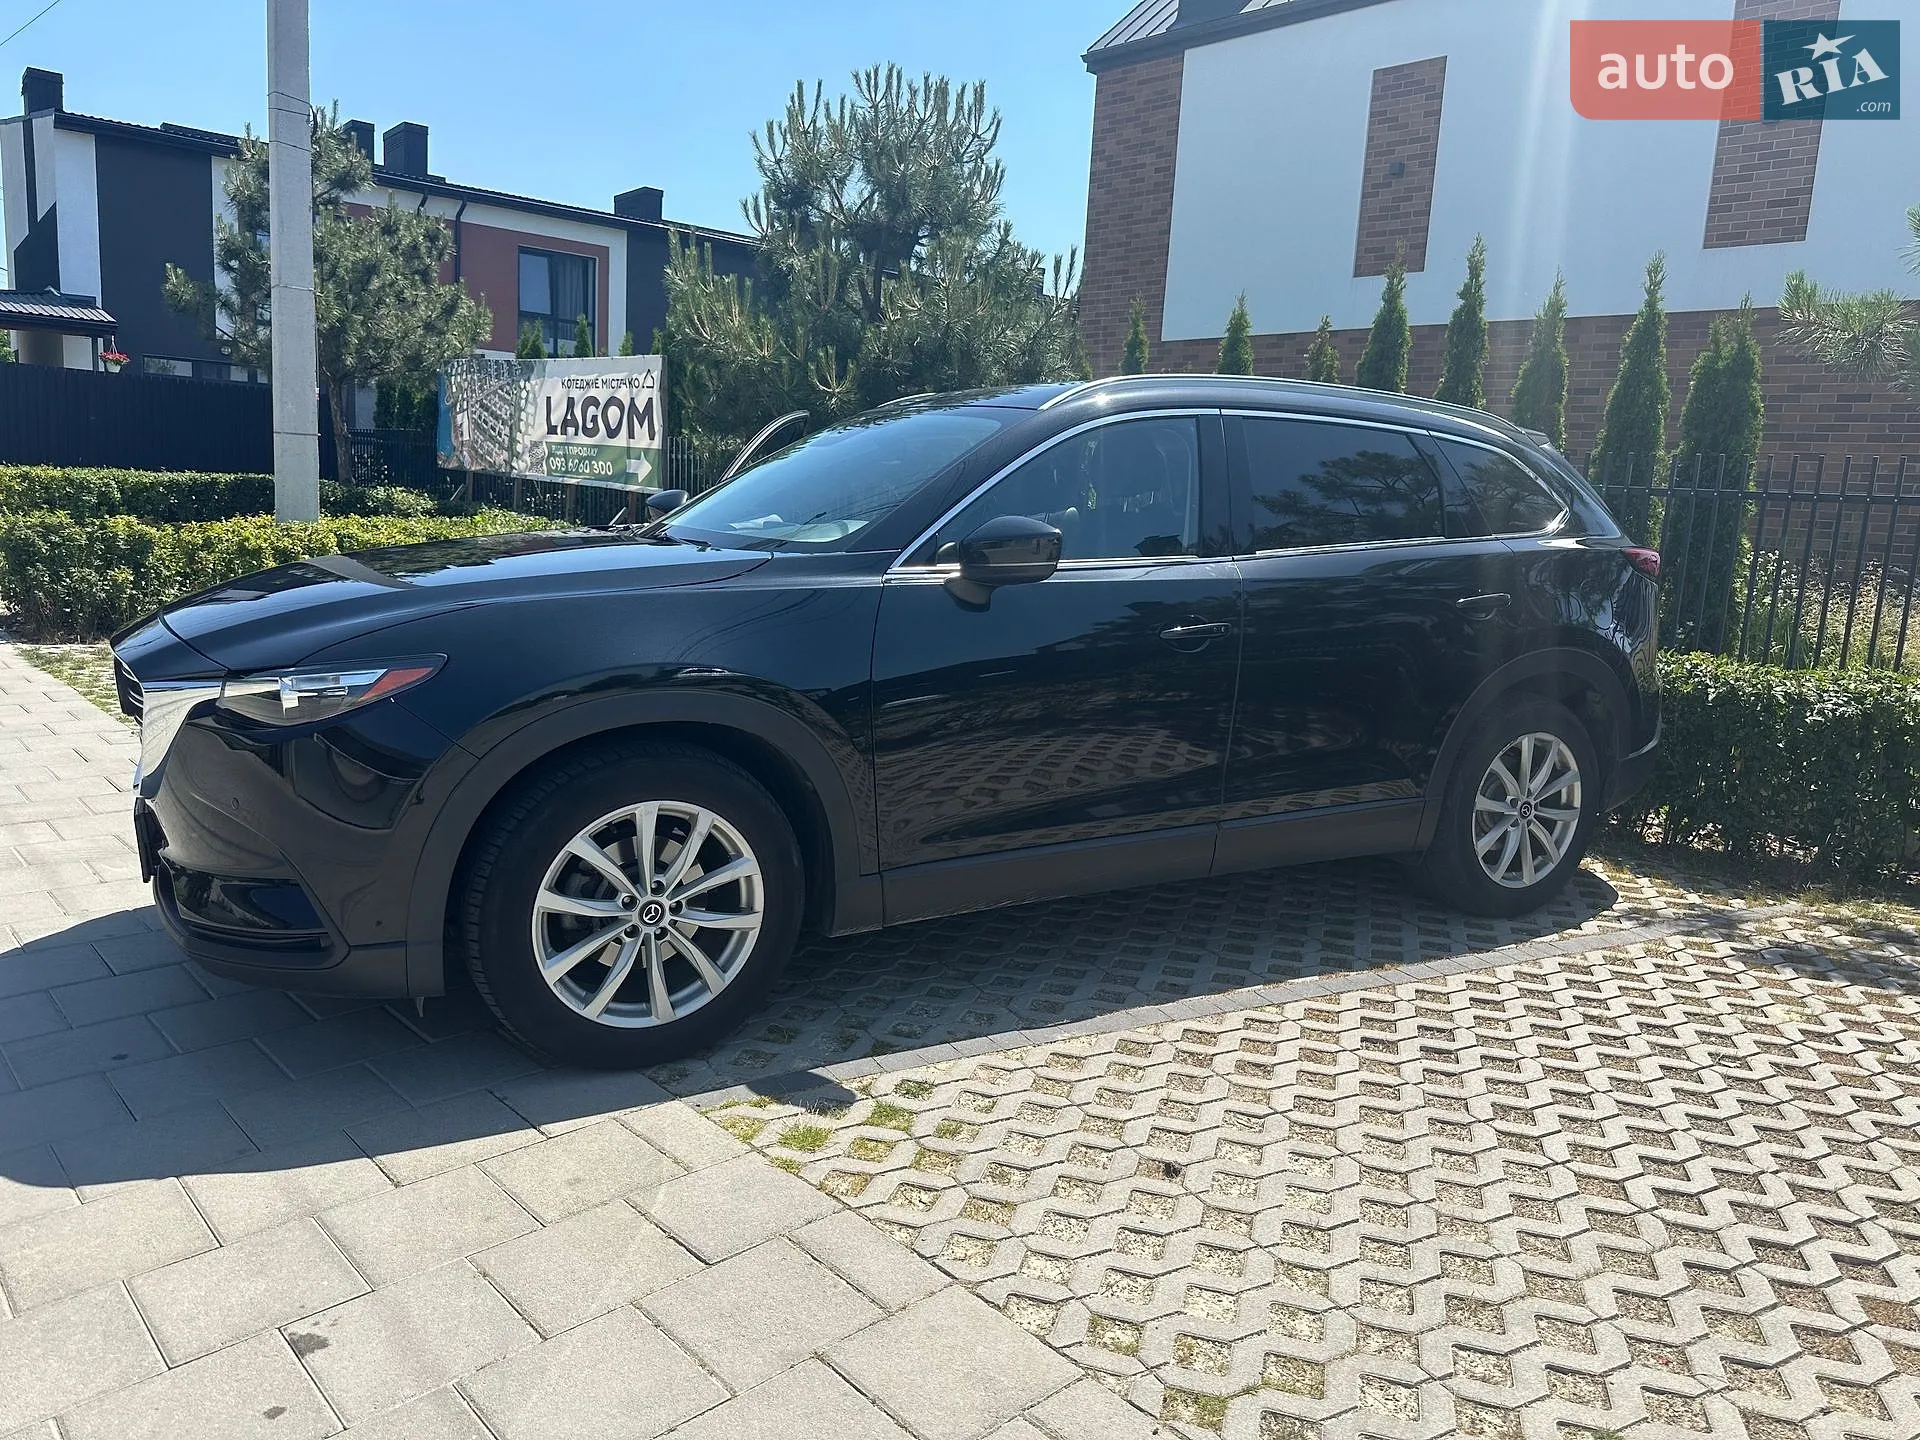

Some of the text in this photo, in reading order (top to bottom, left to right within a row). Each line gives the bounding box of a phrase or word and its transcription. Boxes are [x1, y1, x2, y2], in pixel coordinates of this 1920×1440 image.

[545, 396, 656, 441] LAGOM
[549, 457, 566, 471] 093
[591, 460, 613, 476] 300
